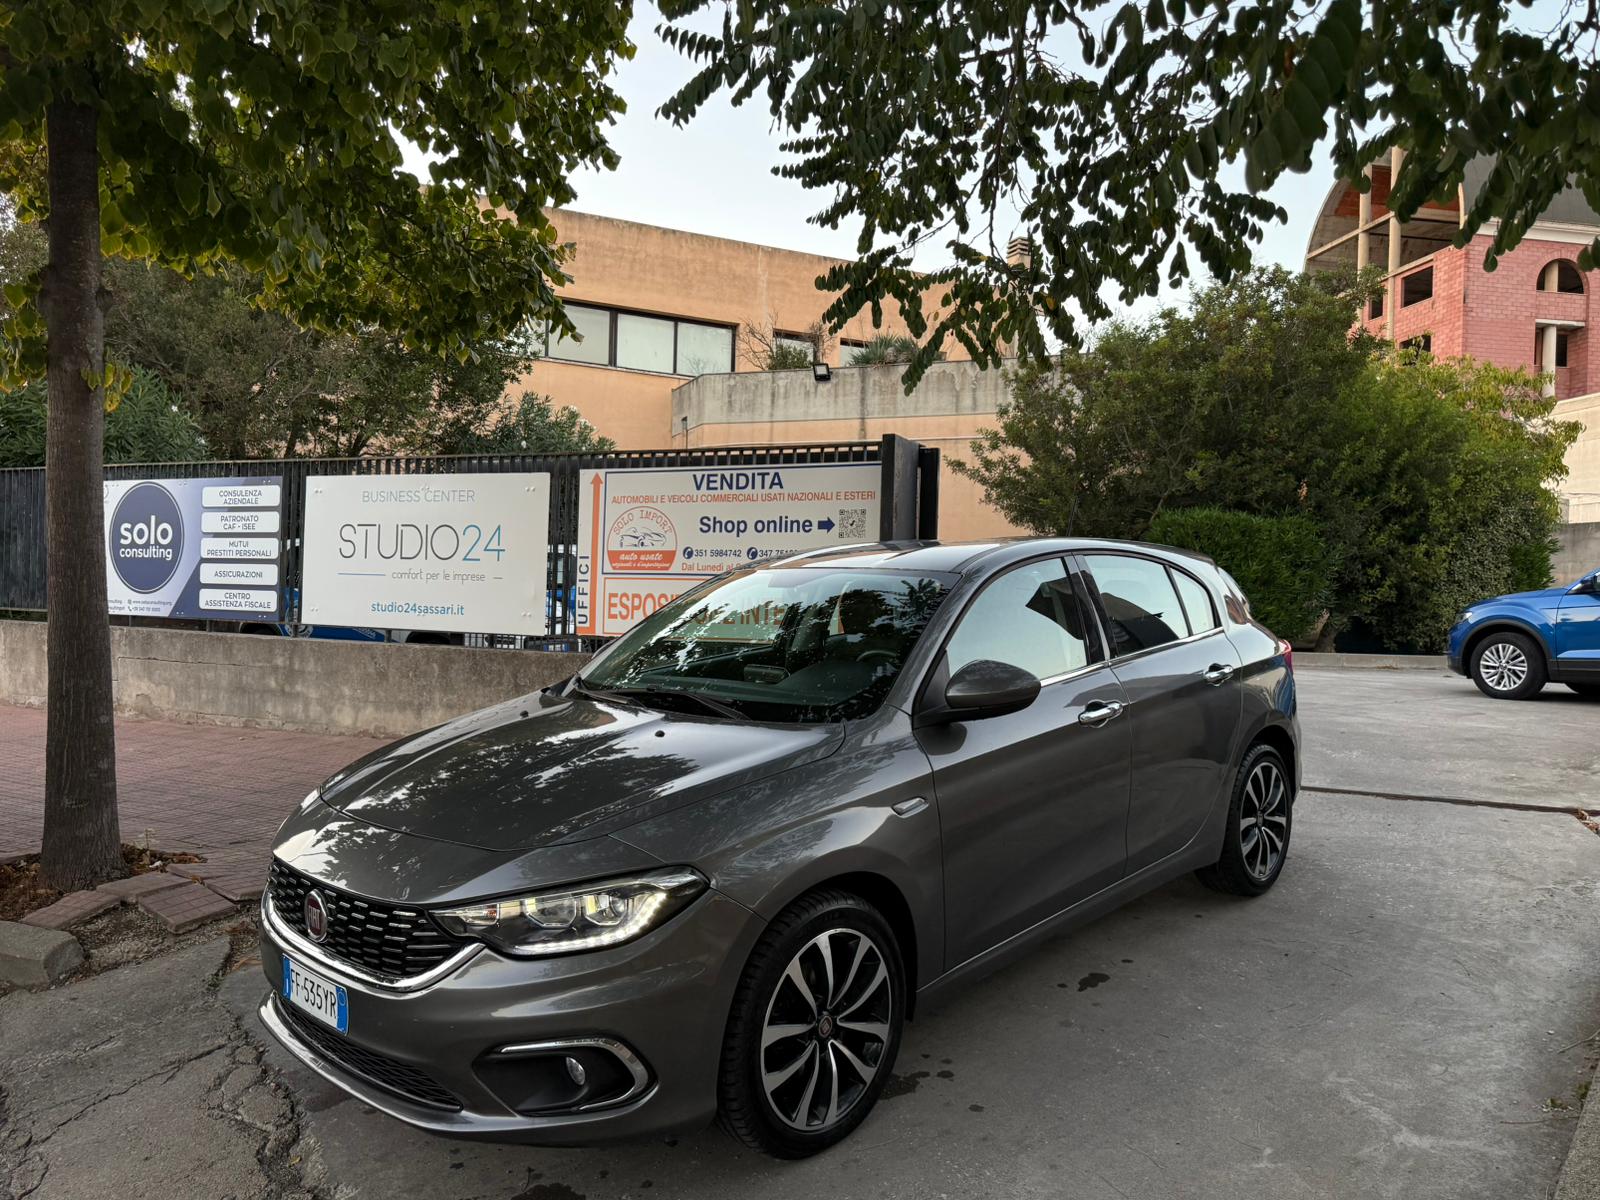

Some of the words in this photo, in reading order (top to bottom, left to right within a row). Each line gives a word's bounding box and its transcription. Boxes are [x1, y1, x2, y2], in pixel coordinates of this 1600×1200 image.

[693, 472, 784, 490] VENDITA
[362, 490, 421, 503] BUSINESS
[424, 490, 475, 503] CENTER
[611, 495, 658, 504] AUTOMOBILI
[660, 495, 666, 503] E
[668, 494, 698, 503] VEICOLI
[700, 493, 758, 503] COMMERCIALI
[760, 492, 785, 502] USATI
[788, 491, 833, 501] NAZIONALI
[836, 491, 841, 500] E
[844, 491, 876, 500] ESTERI
[220, 515, 259, 523] PATRONATO
[613, 512, 634, 535] SOLO
[640, 509, 672, 534] IMPORT
[120, 515, 173, 545] solo
[223, 523, 236, 531] CAF
[242, 523, 256, 531] ISEE
[699, 516, 748, 537] Shop
[755, 515, 813, 533] online
[339, 524, 506, 562] STUDIO24
[119, 545, 173, 561] consulting
[206, 549, 234, 557] PRESTITI
[236, 549, 272, 557] PERSONALI
[694, 549, 707, 557] 351
[710, 549, 742, 557] 5984742
[759, 549, 773, 557] 347
[681, 562, 695, 571] Dal
[214, 570, 263, 578] ASSICURAZIONI
[392, 568, 423, 580] comfort
[425, 571, 440, 584] per
[443, 569, 450, 580] le
[453, 570, 485, 584] imprese
[224, 592, 251, 600] CENTRO
[578, 555, 590, 625] UFFICI
[205, 600, 243, 608] ASSISTENZA
[371, 602, 465, 616] studio24sassari.it
